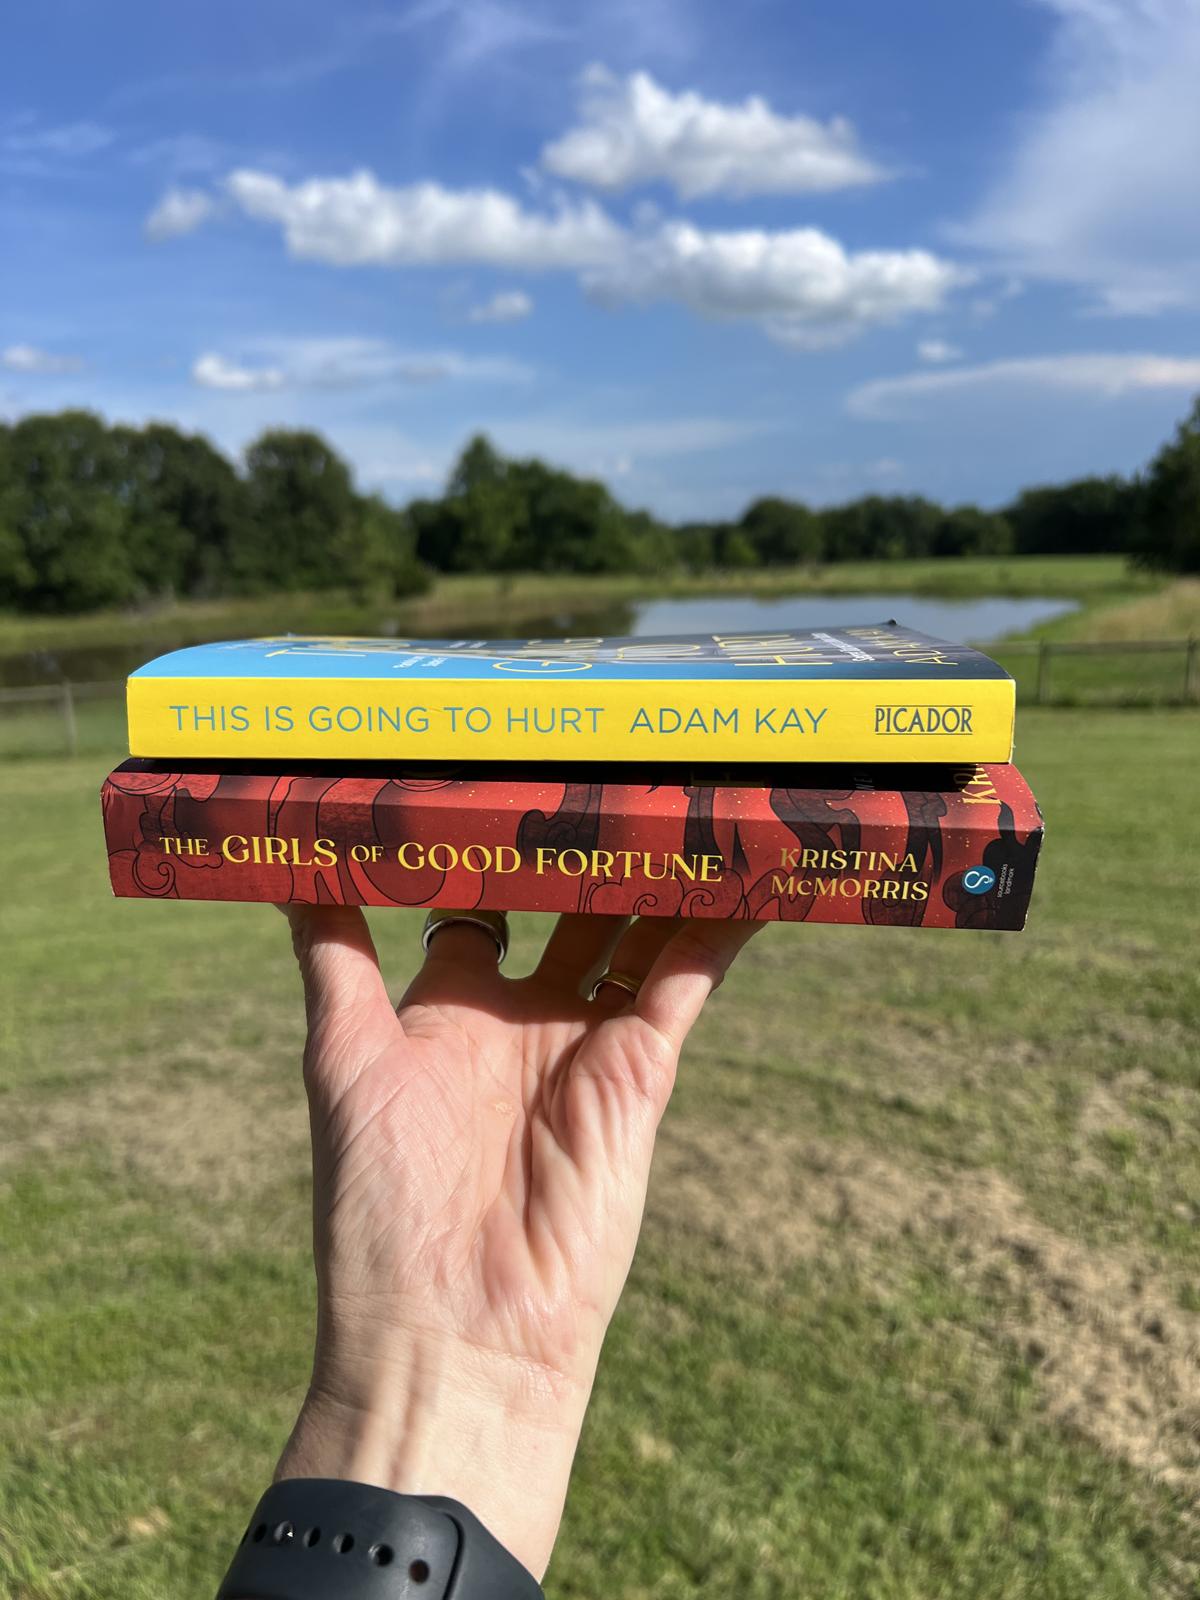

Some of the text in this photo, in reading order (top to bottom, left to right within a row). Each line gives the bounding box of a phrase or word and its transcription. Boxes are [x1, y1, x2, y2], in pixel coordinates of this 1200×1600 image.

[169, 705, 605, 733] THIS IS GOING TO HURT
[629, 708, 828, 734] ADAM KAY
[874, 705, 973, 735] PICADOR
[159, 835, 724, 882] THE GIRLS OF GOOD FORTUNE
[780, 848, 918, 873] KRISTINA
